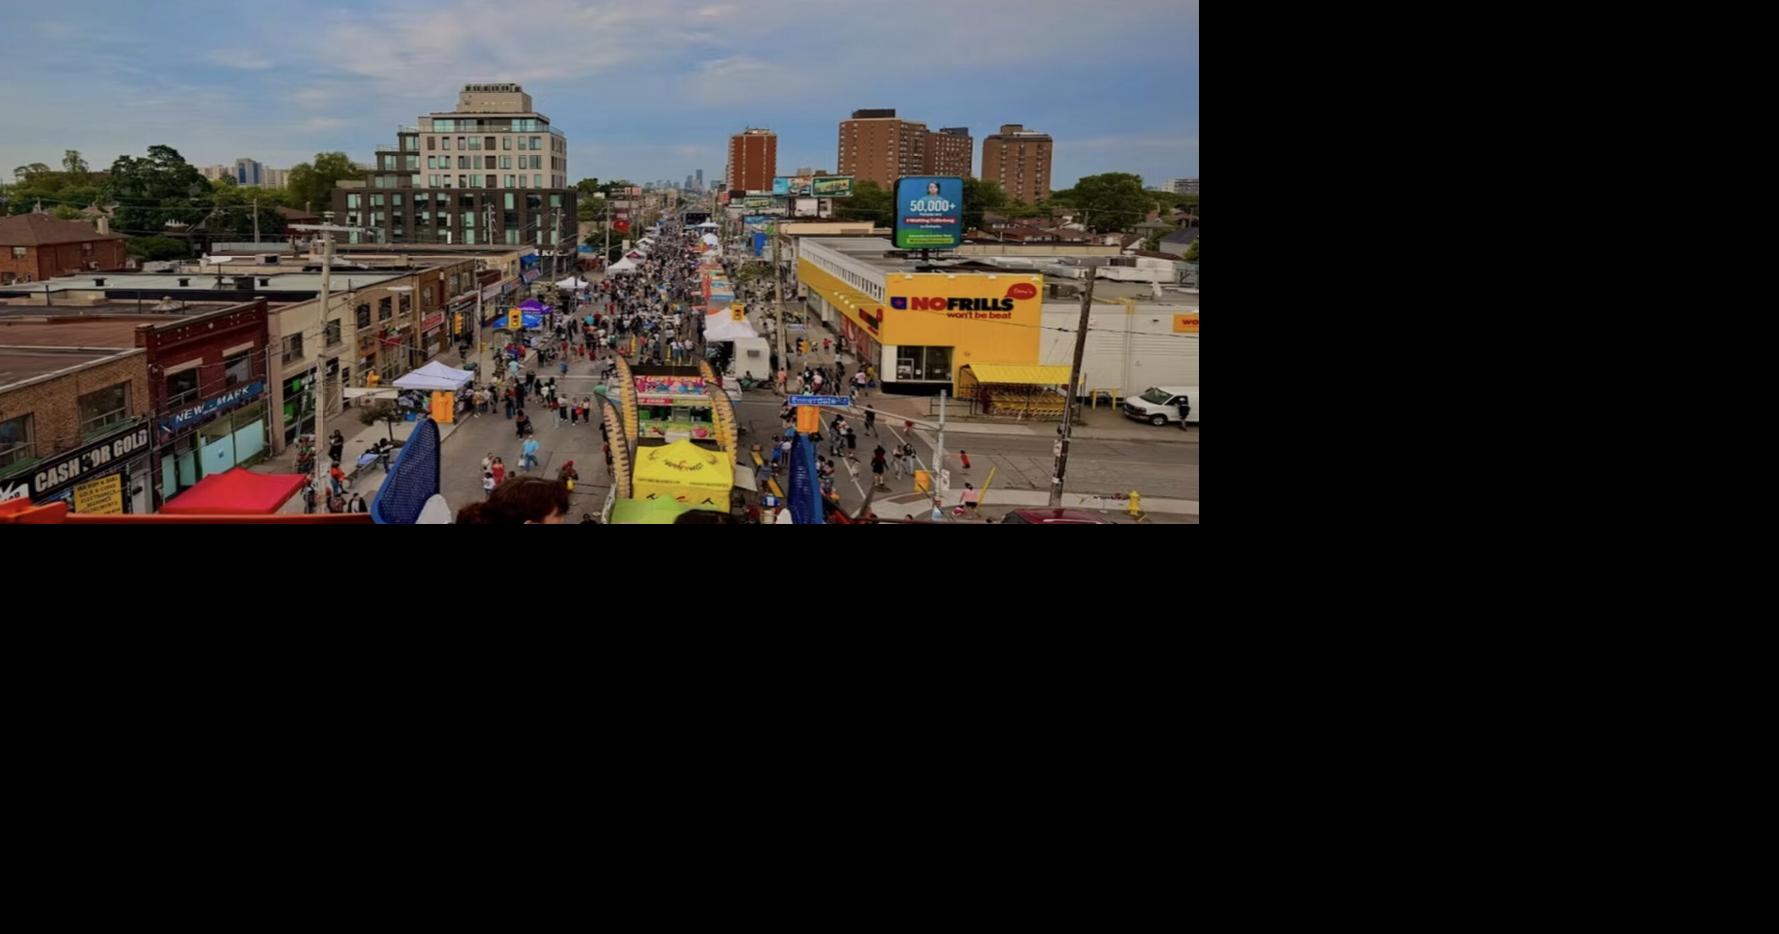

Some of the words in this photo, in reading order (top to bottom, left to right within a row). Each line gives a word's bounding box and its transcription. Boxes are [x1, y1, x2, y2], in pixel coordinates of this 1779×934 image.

[910, 200, 956, 213] 50,000+
[911, 297, 1014, 311] NOFRILLS
[175, 403, 205, 423] NEW
[35, 458, 80, 492] CASH
[113, 429, 148, 458] GOLD
